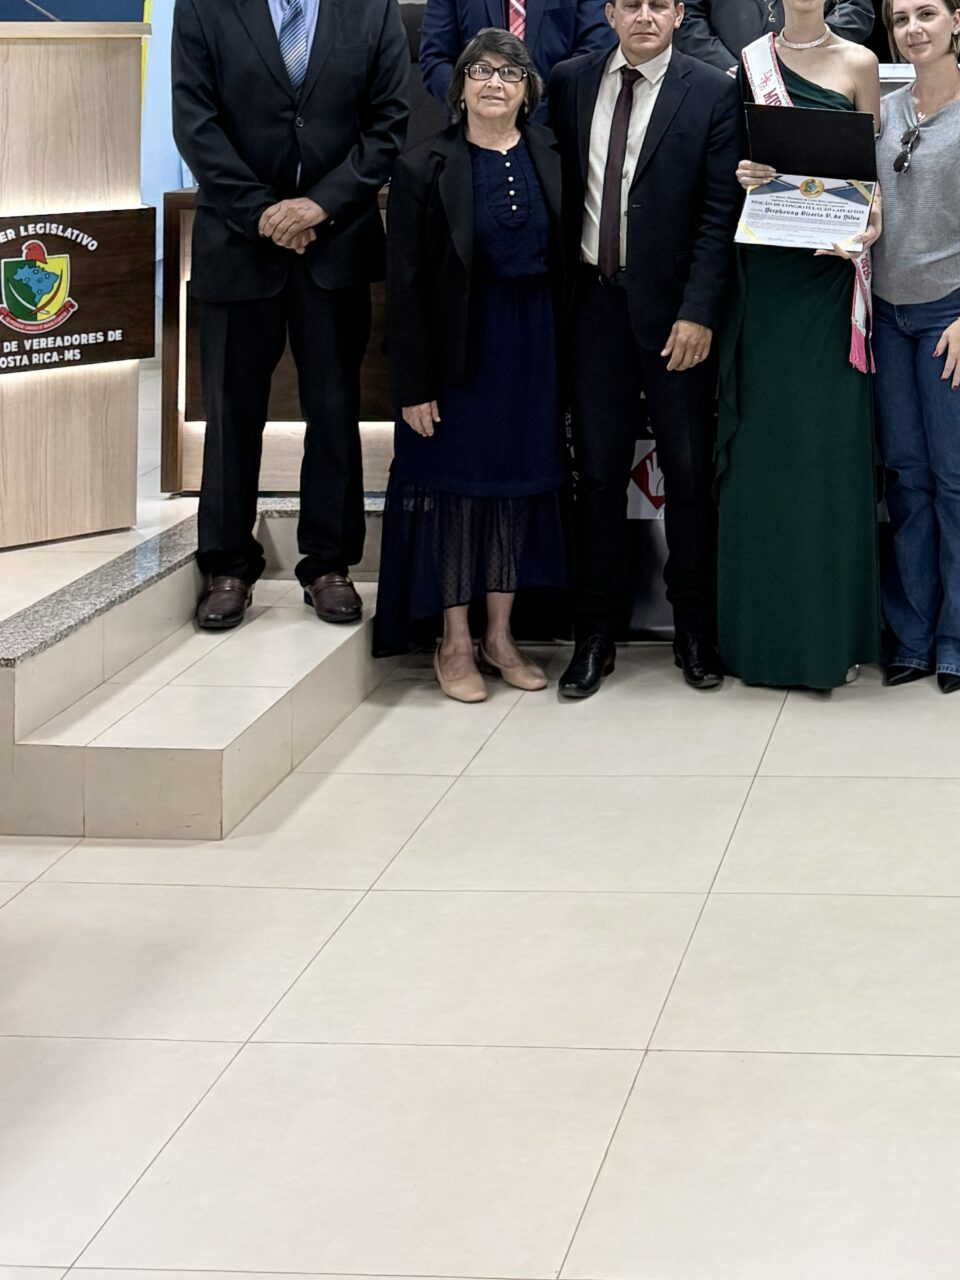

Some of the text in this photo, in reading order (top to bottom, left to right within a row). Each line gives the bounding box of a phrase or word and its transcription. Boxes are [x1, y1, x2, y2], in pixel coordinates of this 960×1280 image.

[19, 222, 99, 252] LEGISLATIVO
[3, 329, 123, 353] DE VEREADORES DE
[0, 348, 81, 369] OSTA RICA-MS
